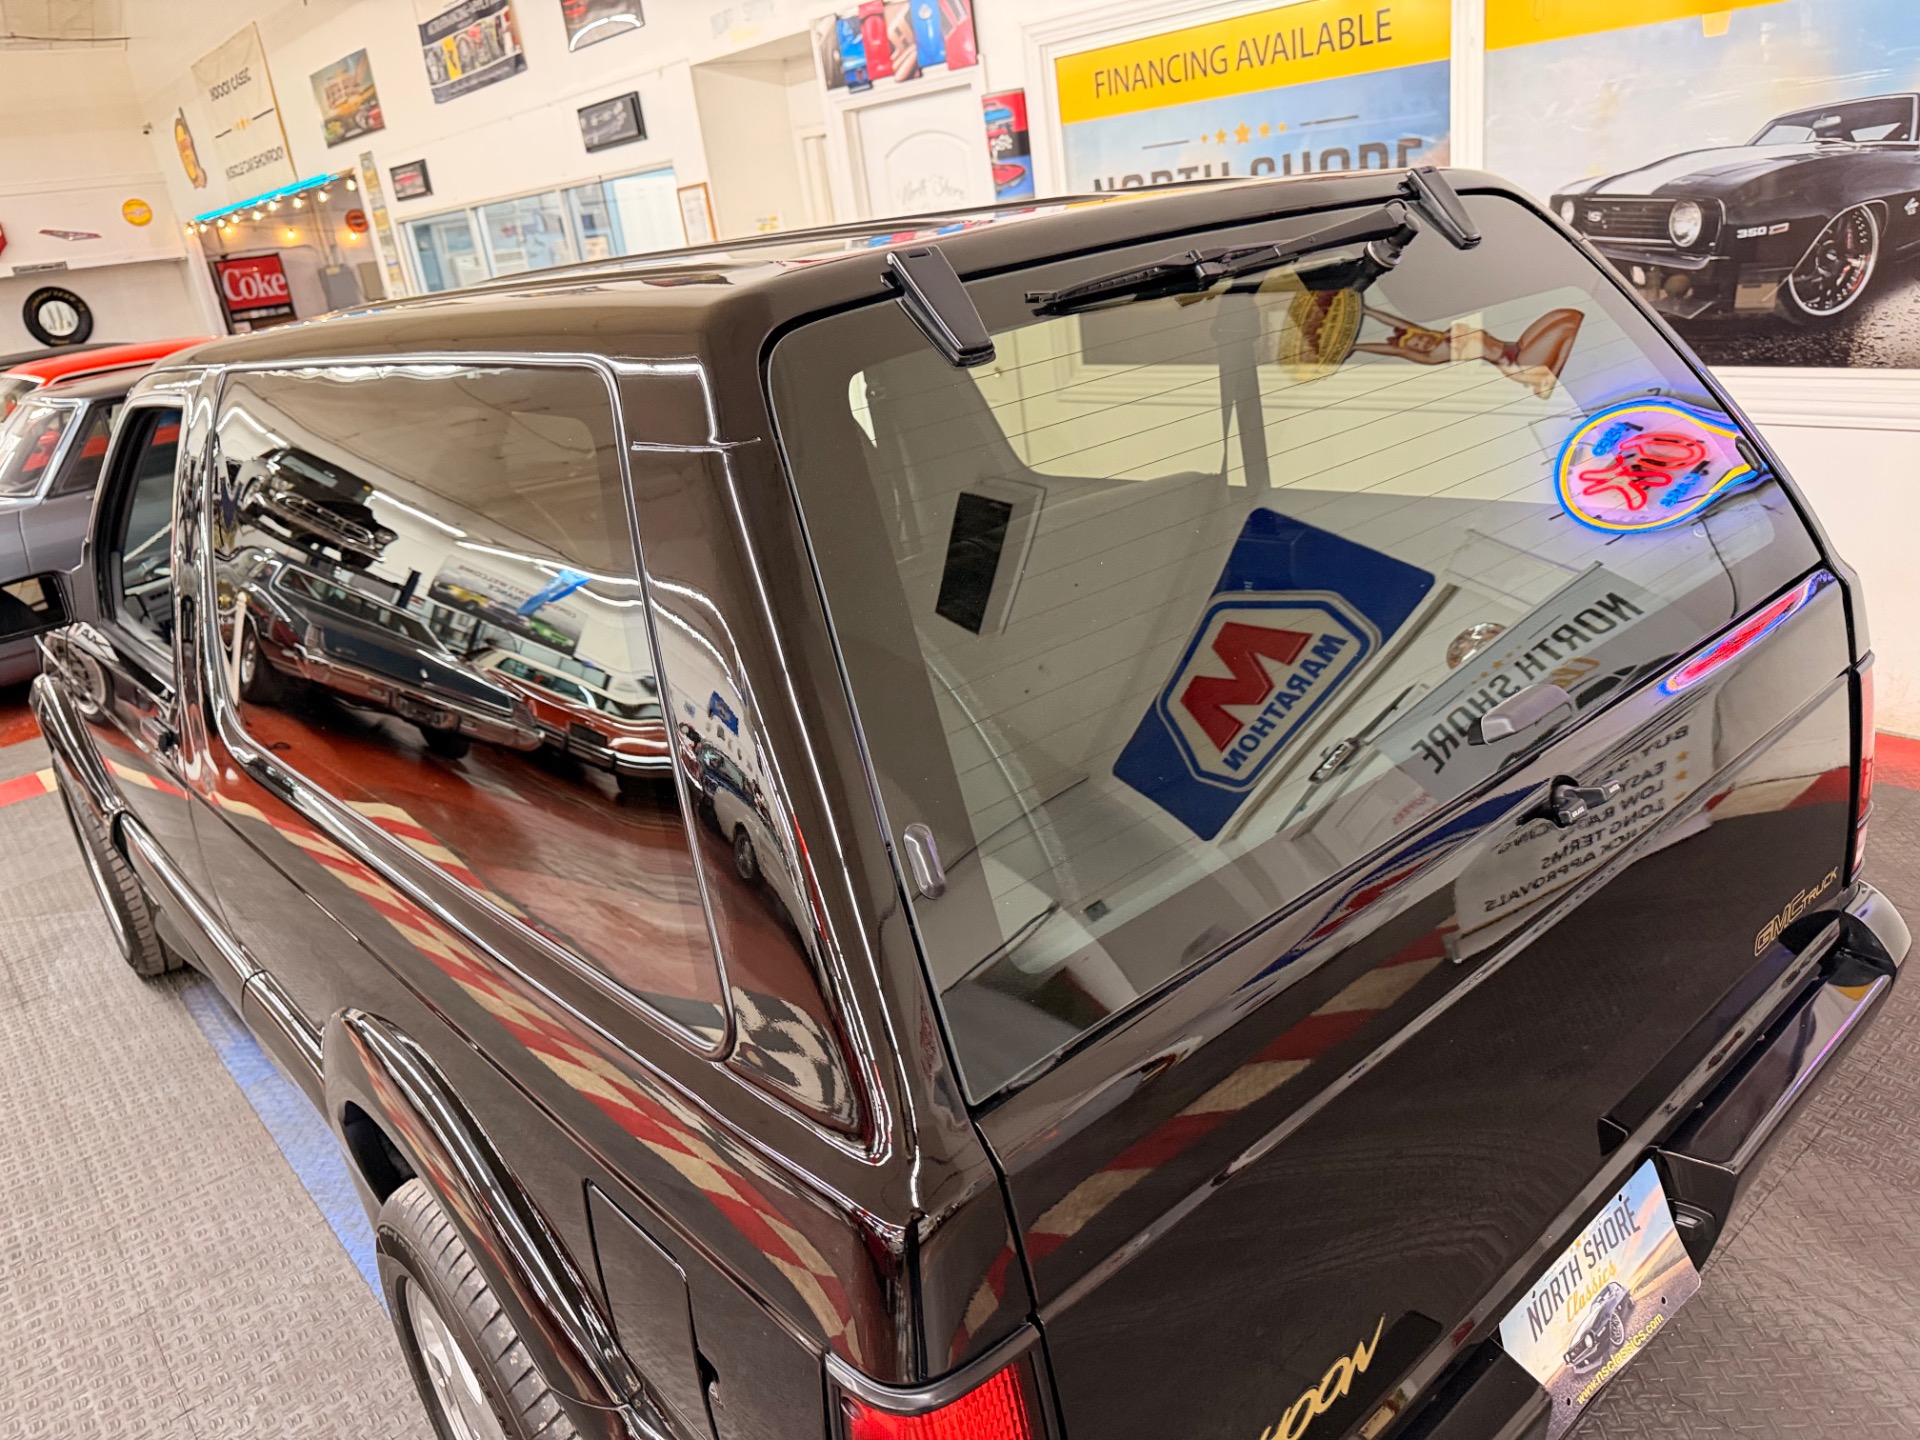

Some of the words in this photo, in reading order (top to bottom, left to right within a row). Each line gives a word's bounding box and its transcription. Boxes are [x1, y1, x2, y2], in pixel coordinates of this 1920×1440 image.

[1094, 45, 1228, 98] FINANCING
[1236, 8, 1392, 71] AVAILABLE
[1736, 226, 1767, 239] 350
[222, 268, 289, 301] Coke
[1754, 889, 1806, 957] GMC
[1802, 866, 1838, 909] TRUCK
[1526, 1257, 1583, 1344] NORTH
[1583, 1196, 1641, 1270] SHORE
[1566, 1259, 1617, 1323] Classics
[1576, 1313, 1665, 1405] www.nsclassics.com
